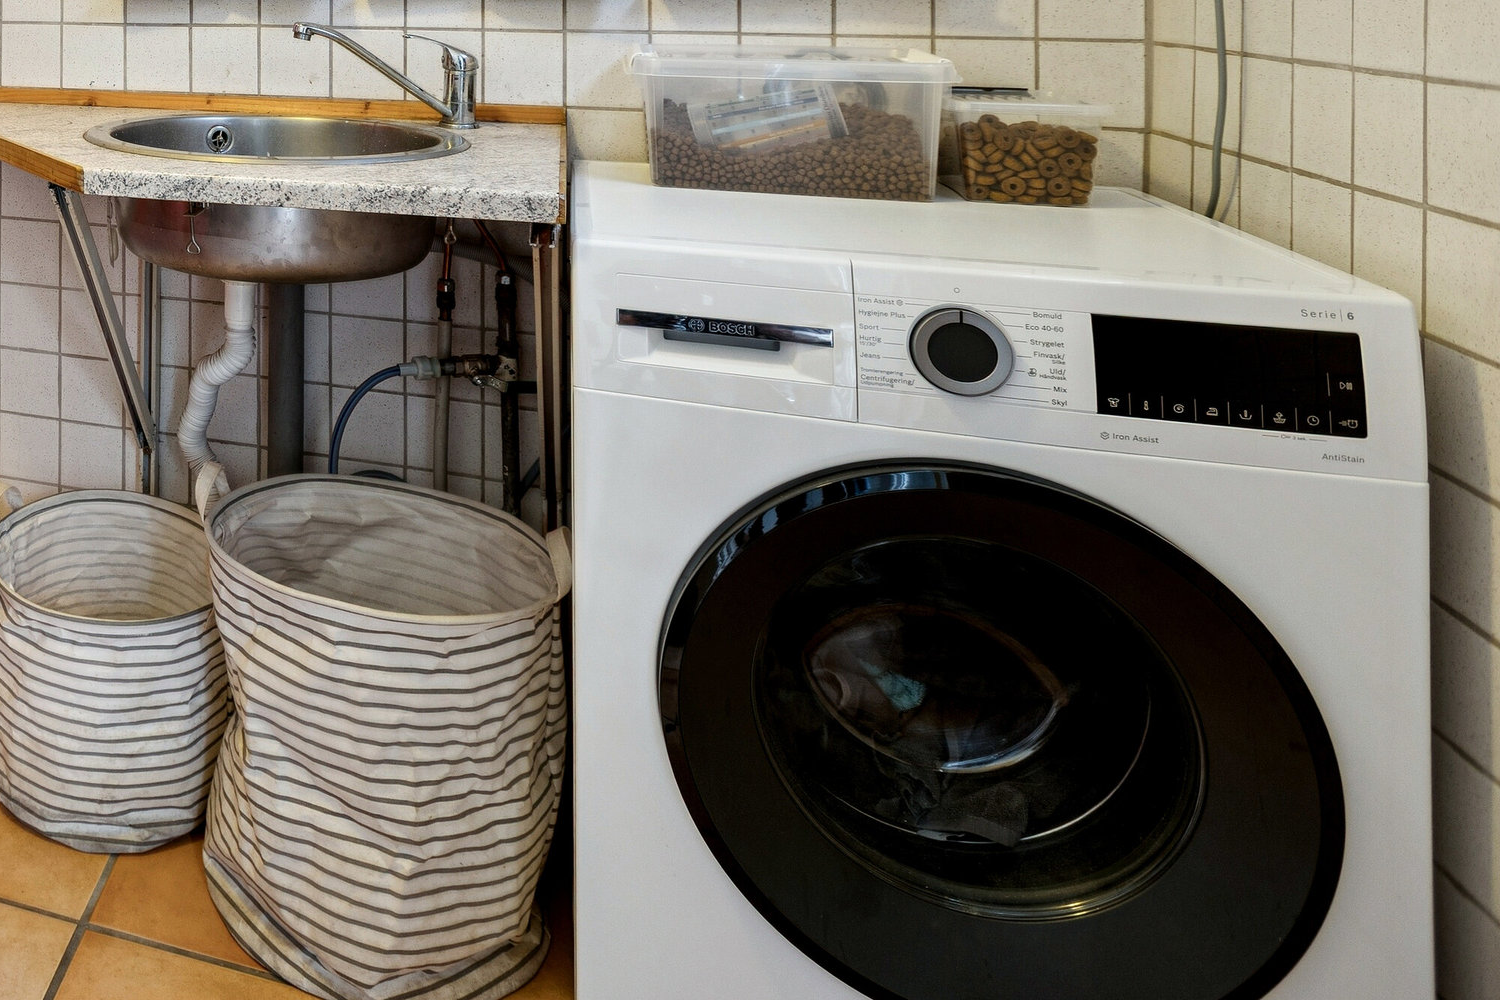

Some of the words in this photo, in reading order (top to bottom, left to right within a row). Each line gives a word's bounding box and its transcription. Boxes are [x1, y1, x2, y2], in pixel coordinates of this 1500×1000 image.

[858, 310, 888, 318] Hygiejne
[1033, 312, 1062, 320] Bomuld
[1301, 308, 1336, 320] Serie
[709, 320, 755, 336] BOSCH
[859, 323, 879, 331] Sport
[1025, 323, 1039, 331] Eco
[1041, 325, 1064, 333] 40-60
[859, 335, 882, 343] Hurtig
[1030, 339, 1065, 348] Strygelet
[1034, 351, 1065, 360] Finvask/
[1052, 399, 1067, 407] Skyl
[1112, 433, 1130, 442] Iron
[1133, 435, 1160, 444] Assist
[1322, 453, 1365, 463] AntiStain
